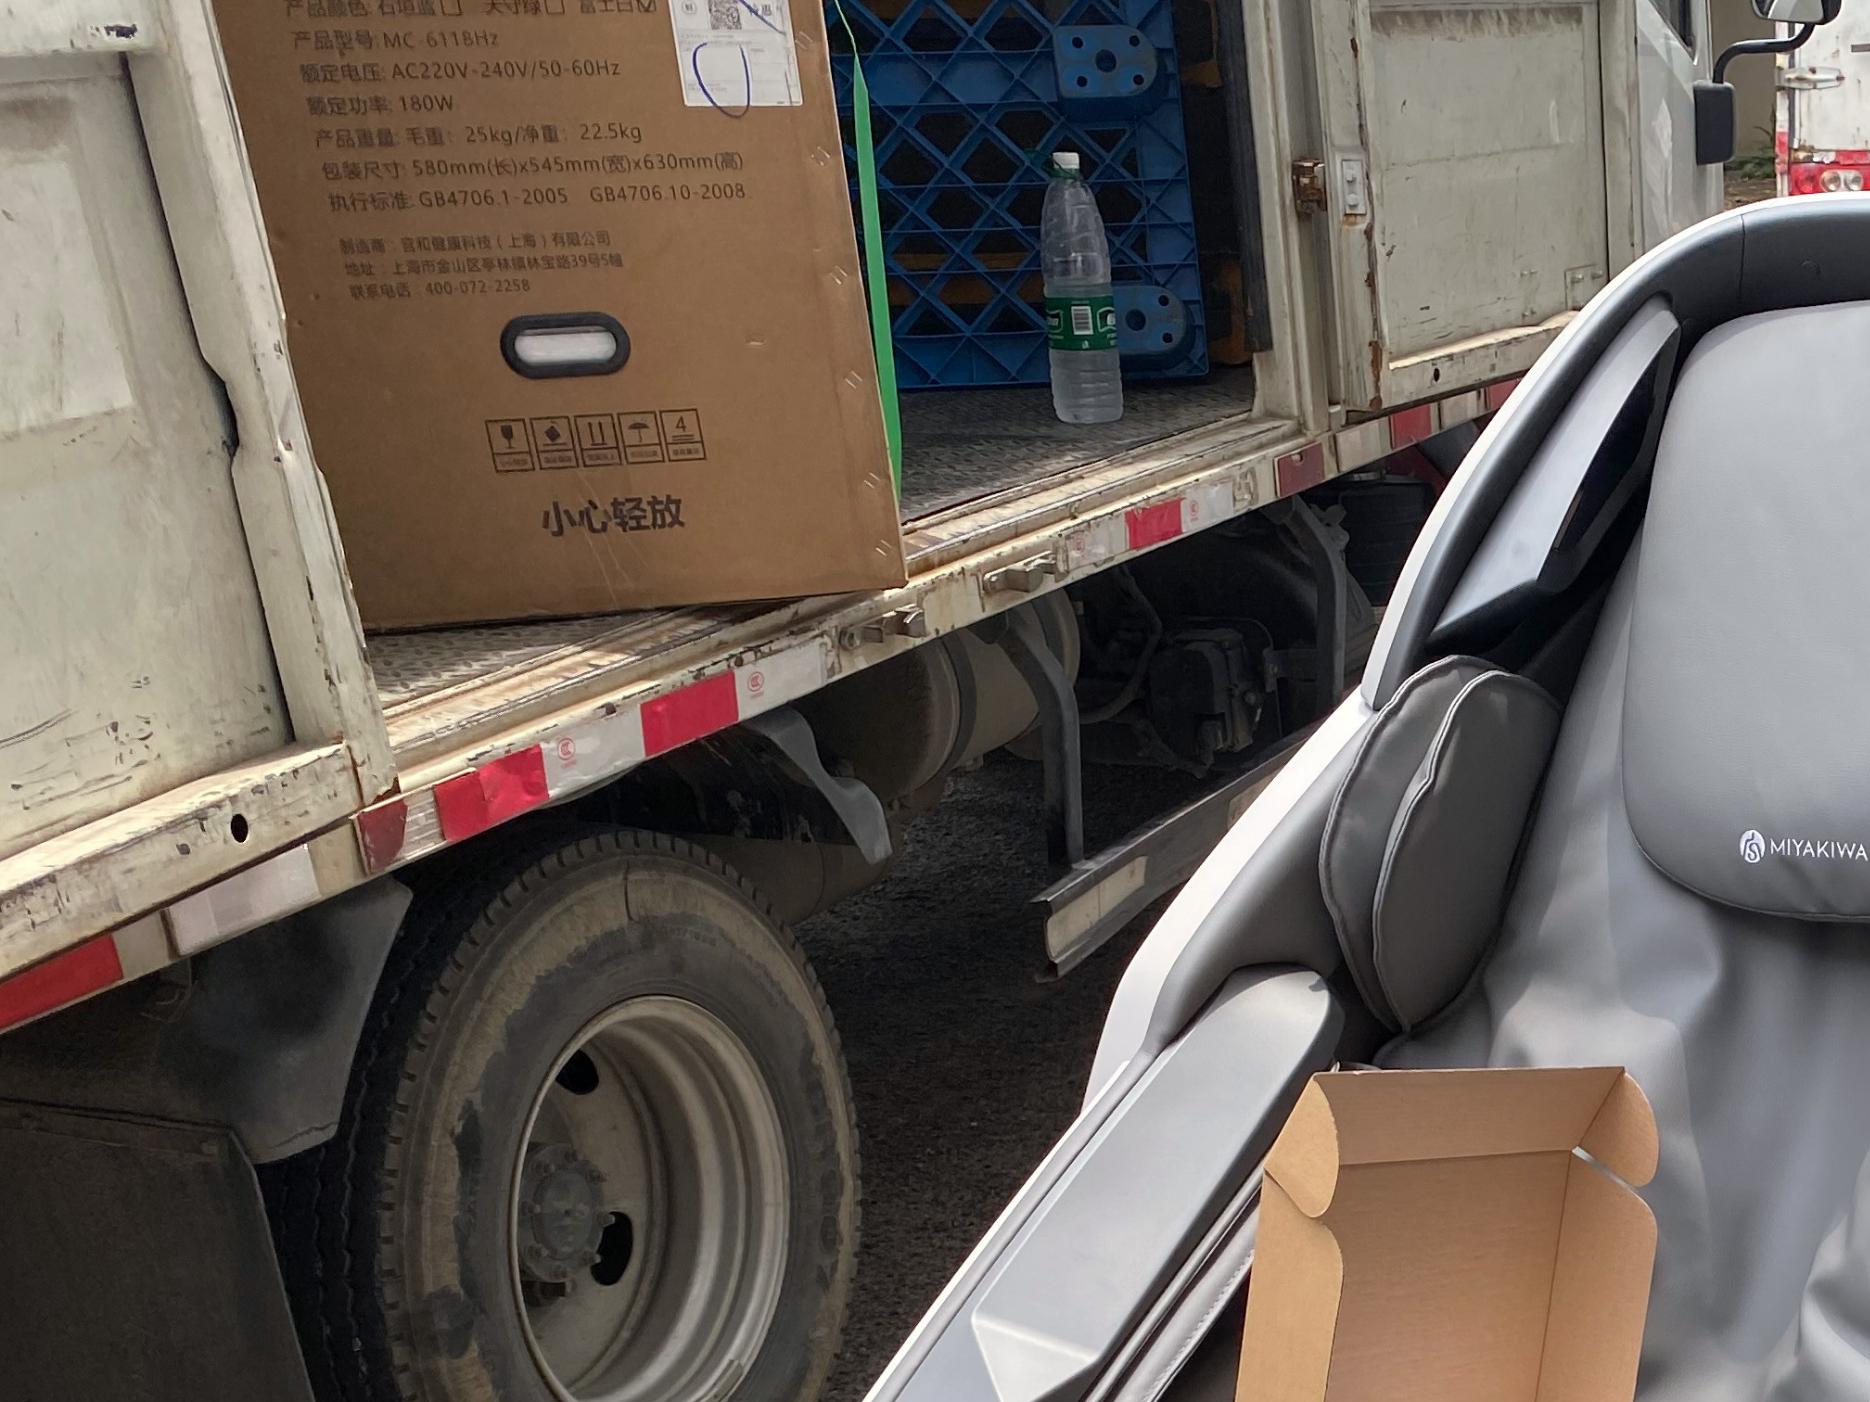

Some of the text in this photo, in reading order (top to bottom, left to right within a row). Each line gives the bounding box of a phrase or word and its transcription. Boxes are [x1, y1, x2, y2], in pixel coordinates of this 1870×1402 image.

[400, 94, 454, 112] 180W
[674, 415, 688, 433] 4
[542, 494, 686, 537] 小心轻放
[1769, 837, 1869, 862] MIYAKIWA
